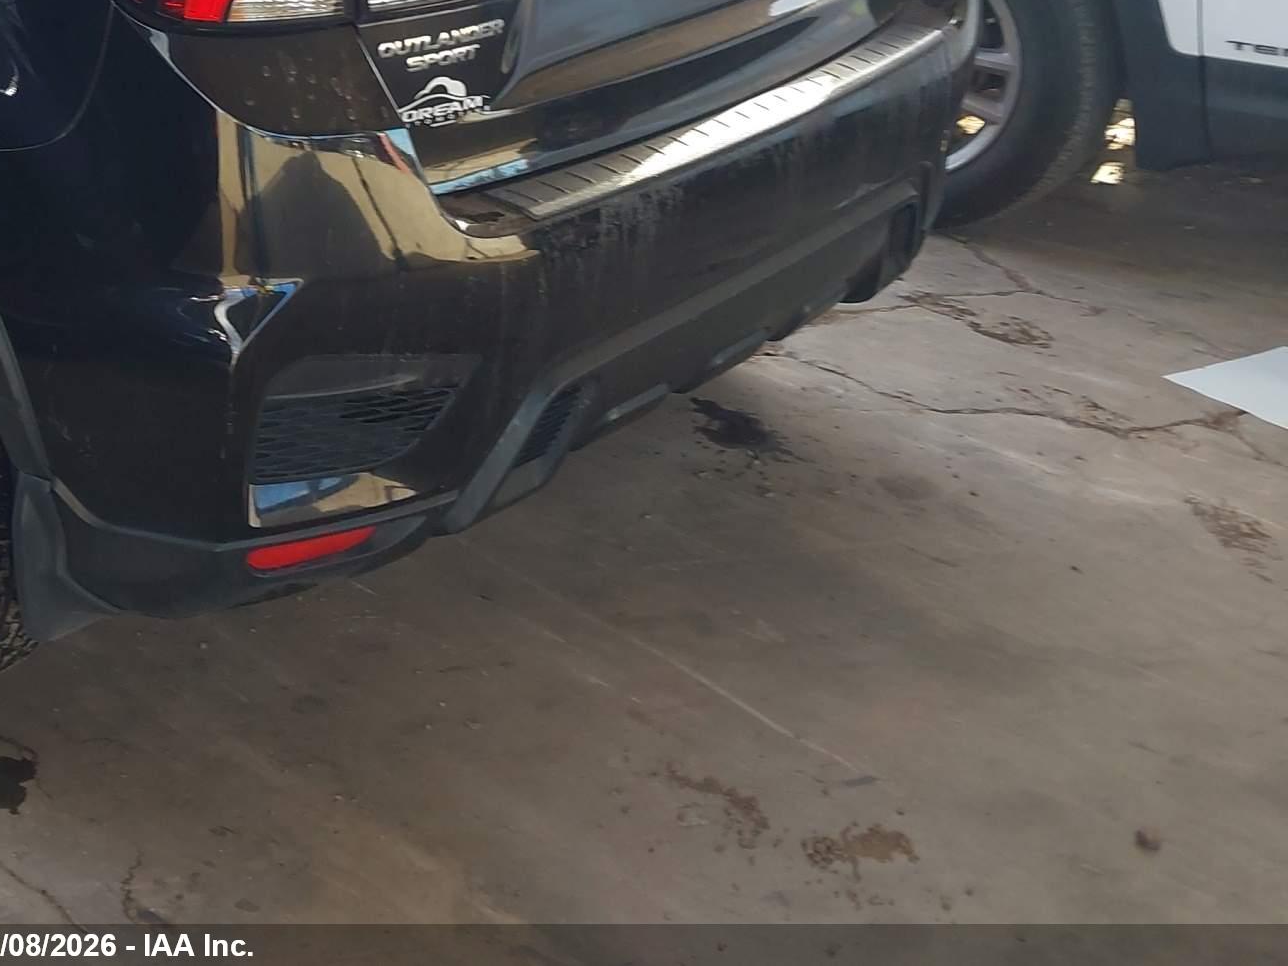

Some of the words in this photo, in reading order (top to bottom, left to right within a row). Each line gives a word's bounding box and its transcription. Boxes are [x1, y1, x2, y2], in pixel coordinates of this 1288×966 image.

[377, 18, 506, 59] OUTLANDER
[406, 43, 481, 72] SPORT
[401, 96, 485, 123] DREAM
